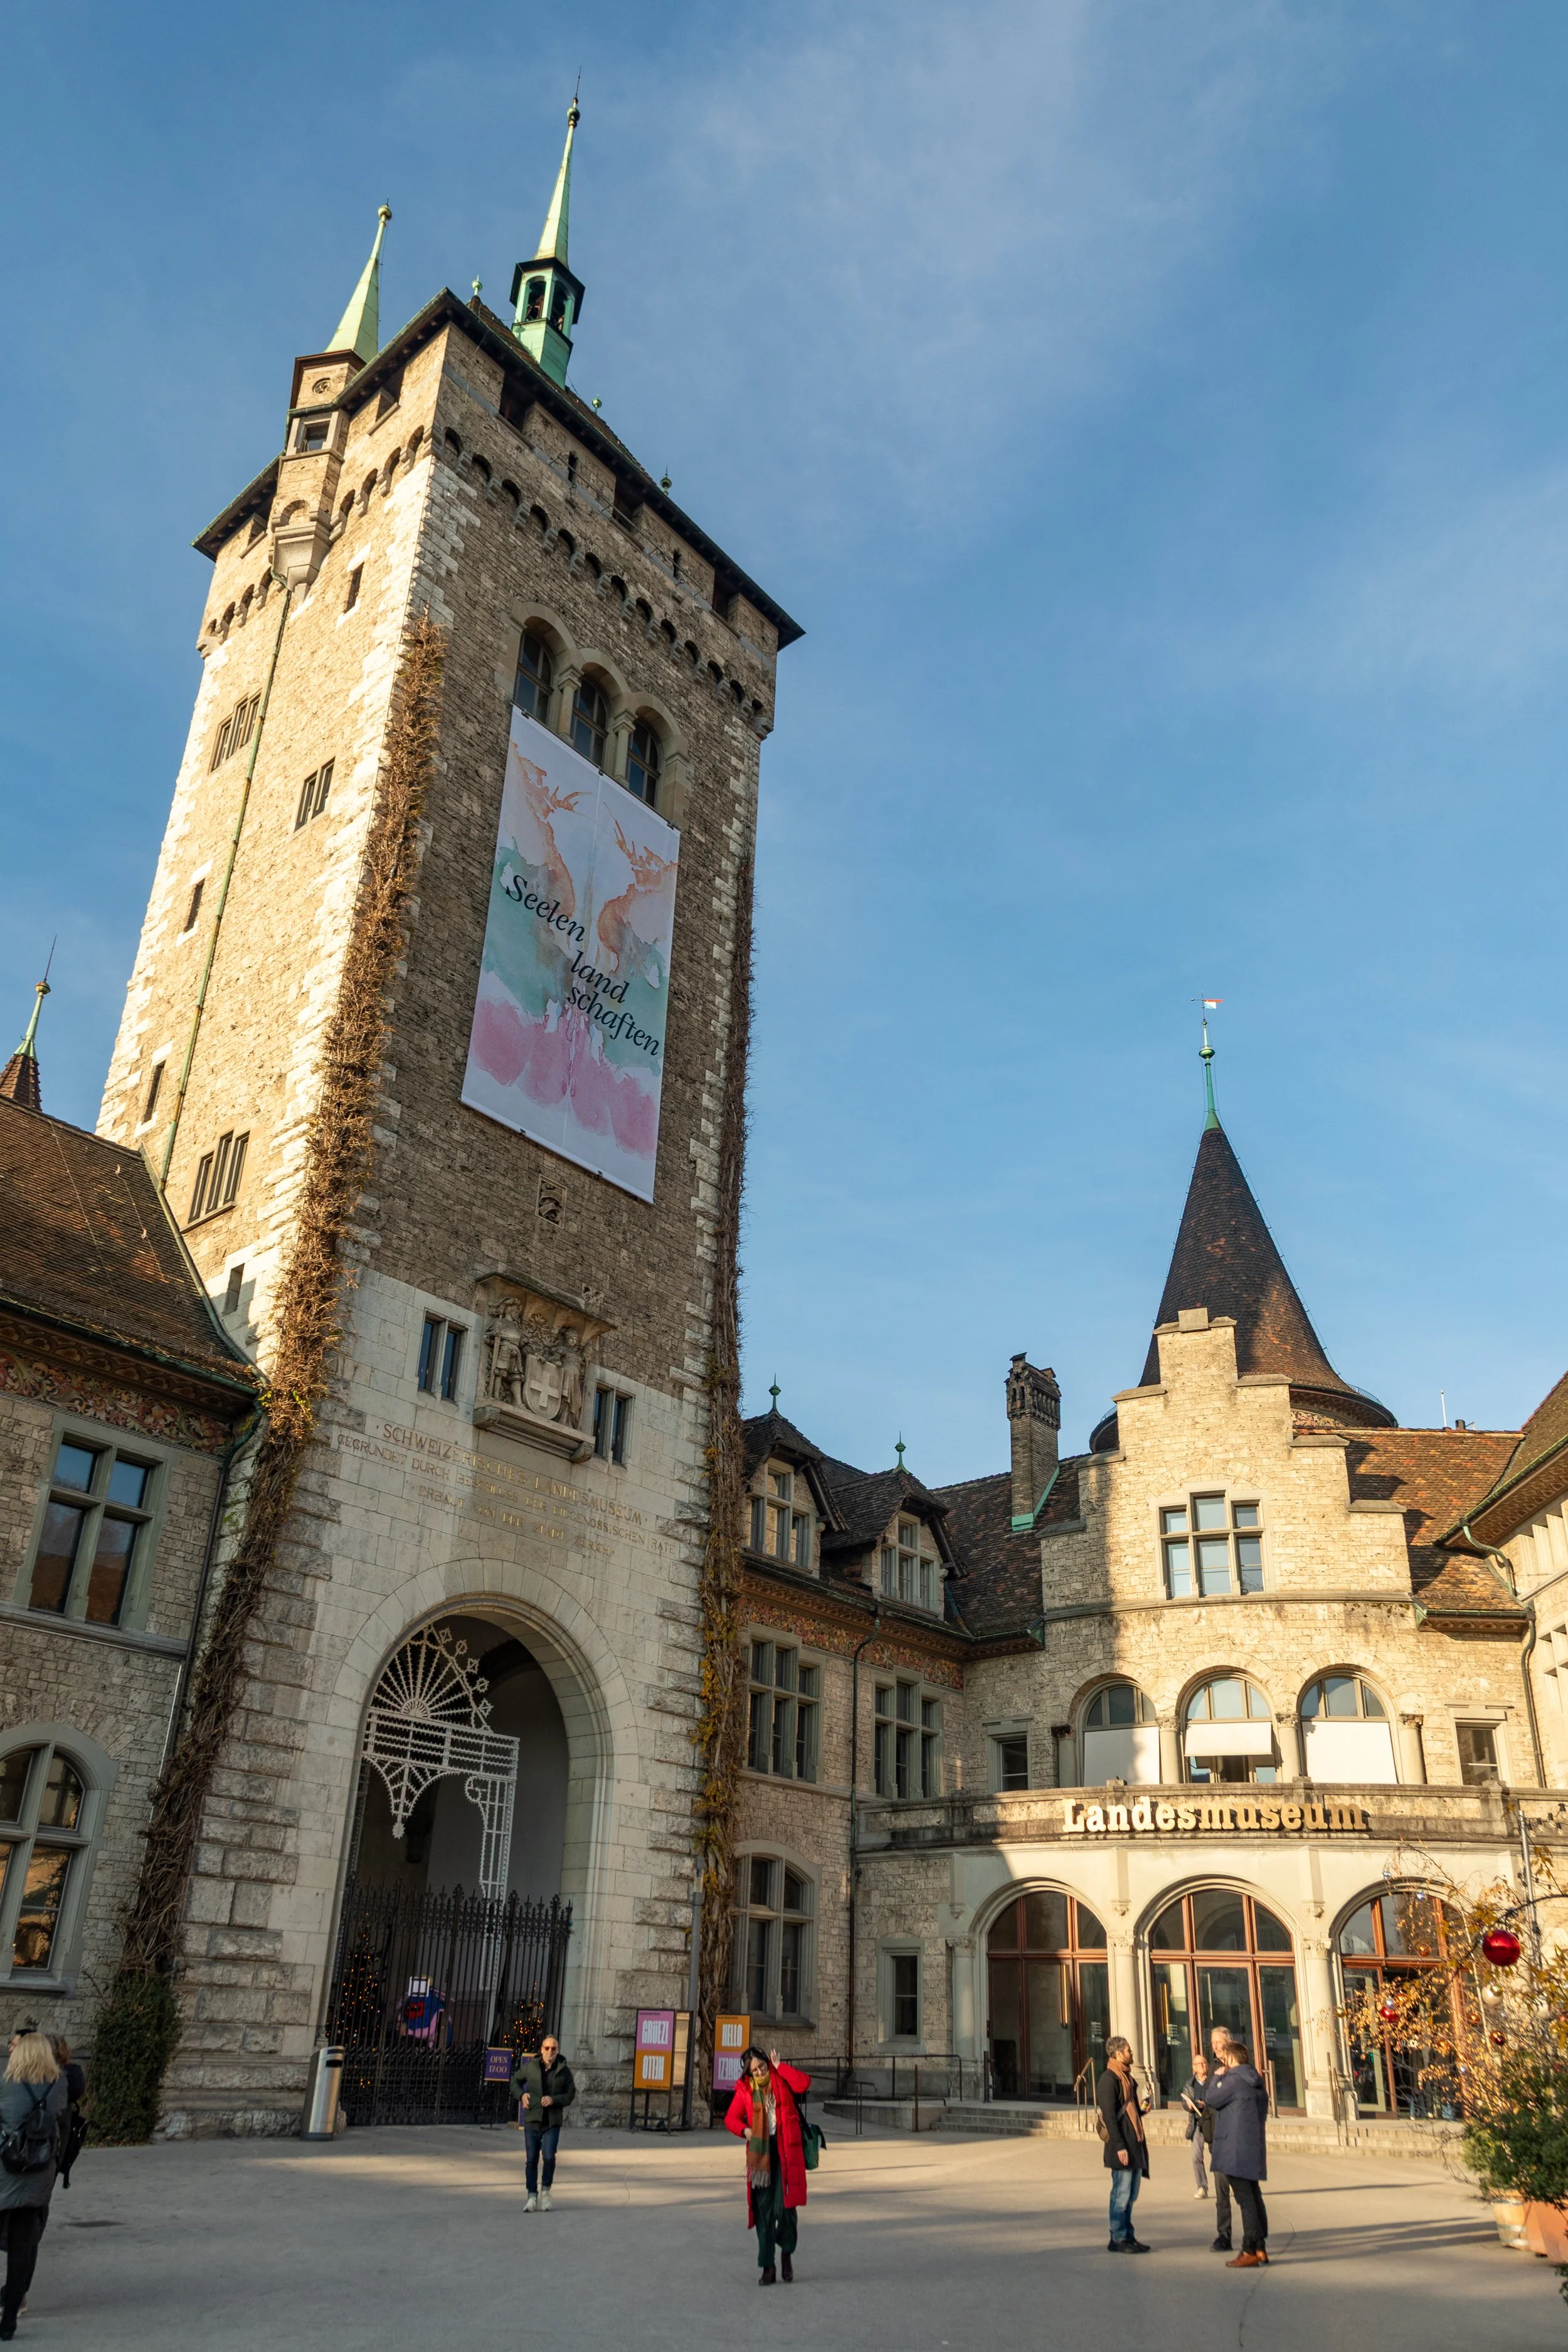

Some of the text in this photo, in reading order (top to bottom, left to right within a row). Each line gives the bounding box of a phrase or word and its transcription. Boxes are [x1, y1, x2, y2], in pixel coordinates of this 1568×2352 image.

[506, 875, 585, 941] Seelen
[571, 950, 630, 1003] land
[567, 987, 659, 1056] schaften
[337, 1434, 407, 1465] GEGRÜNDET
[411, 1458, 450, 1480] DURCH
[457, 1473, 518, 1502] BESCHLUSS
[526, 1496, 548, 1512] DER
[651, 1538, 675, 1554] RATE
[383, 1424, 642, 1525] SCHWEIZERISCHES LANDESMUSEUM
[419, 1485, 464, 1508] ERBAUT
[1061, 1796, 1367, 1833] Landesmuseum
[490, 2055, 508, 2063] OPEN
[722, 2023, 743, 2047] HELLO
